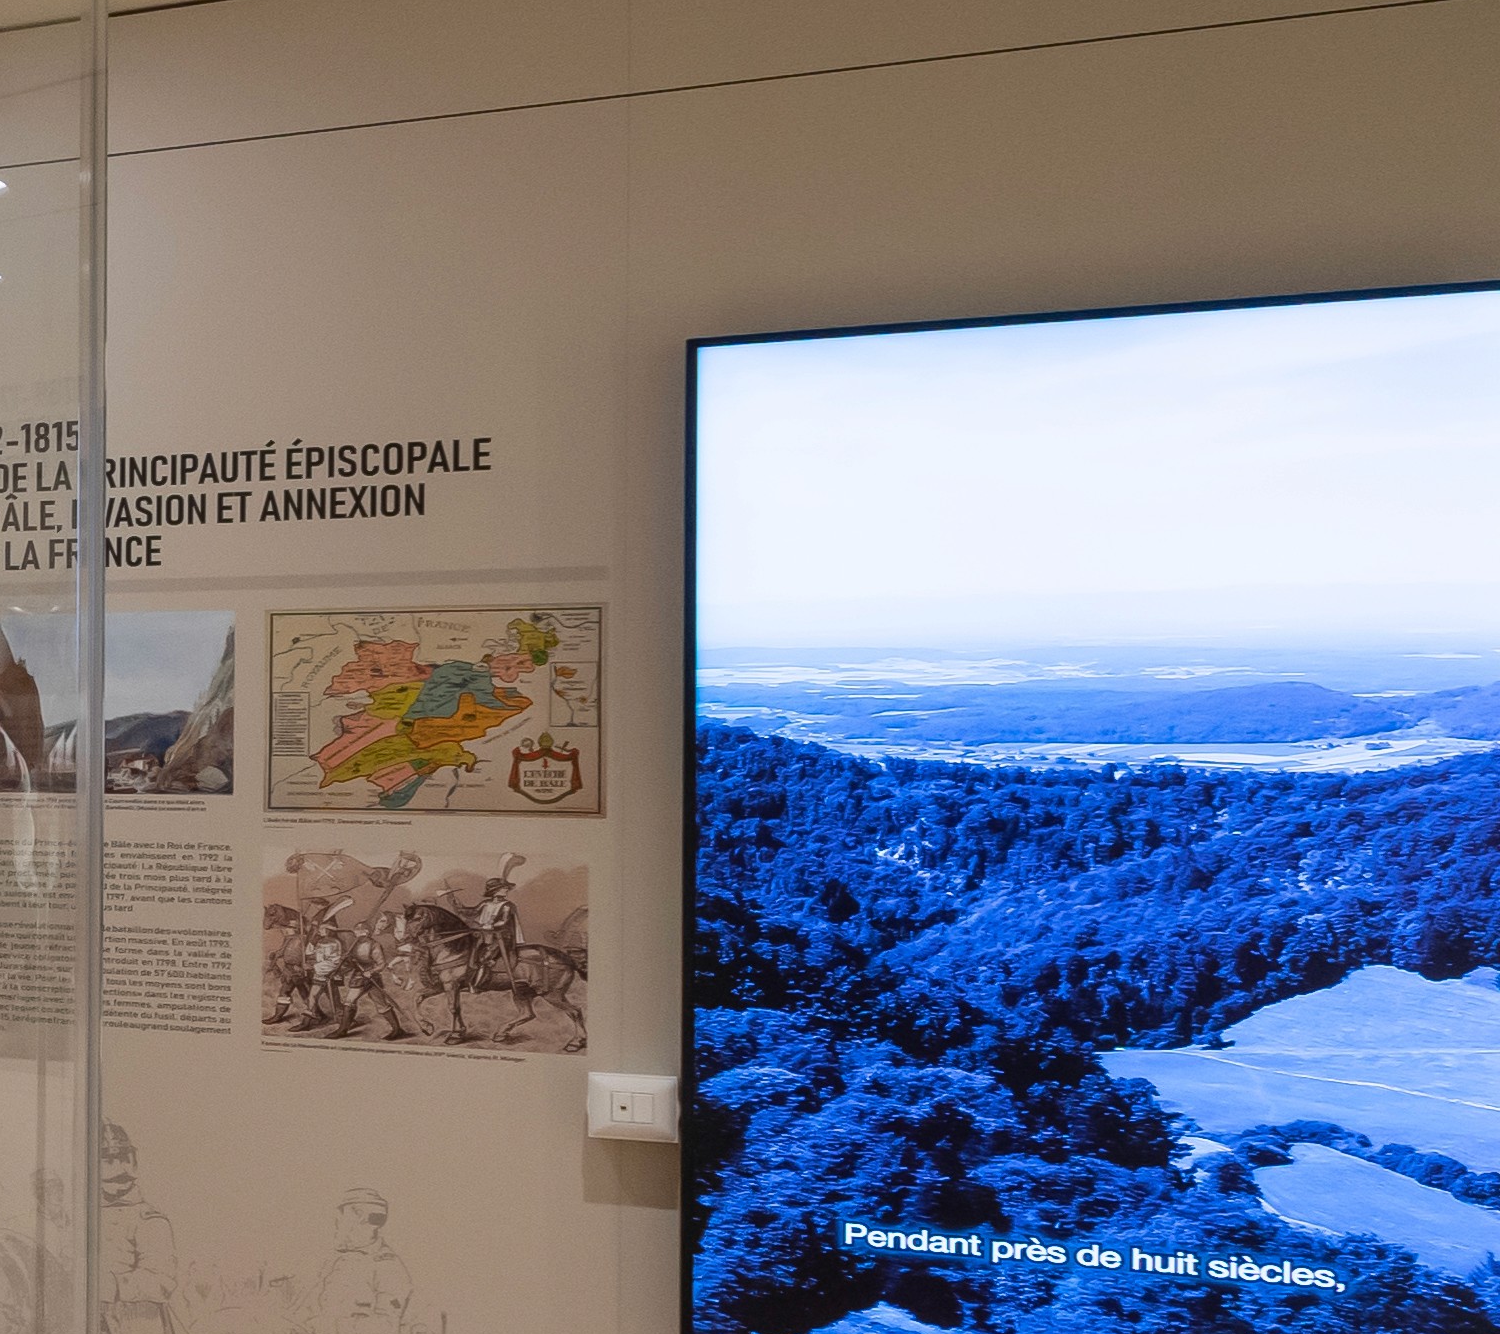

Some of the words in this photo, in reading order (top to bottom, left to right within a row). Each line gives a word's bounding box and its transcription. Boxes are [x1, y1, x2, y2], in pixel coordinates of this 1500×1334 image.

[36, 459, 73, 492] LA
[104, 439, 277, 489] RINCIPAUTÉ
[285, 436, 493, 481] ÉPISCOPALE
[71, 491, 206, 530] IVASION
[216, 490, 253, 524] ET
[258, 482, 426, 523] ANNEXION
[3, 539, 41, 571] LA
[48, 534, 162, 570] FRNCE
[133, 841, 156, 850] avec
[166, 840, 183, 851] Roi
[183, 841, 196, 851] de
[843, 1220, 983, 1258] Pendant
[991, 1236, 1068, 1265] près
[1075, 1243, 1122, 1269] de
[1131, 1247, 1199, 1276] huit
[1207, 1253, 1347, 1293] siècles,
